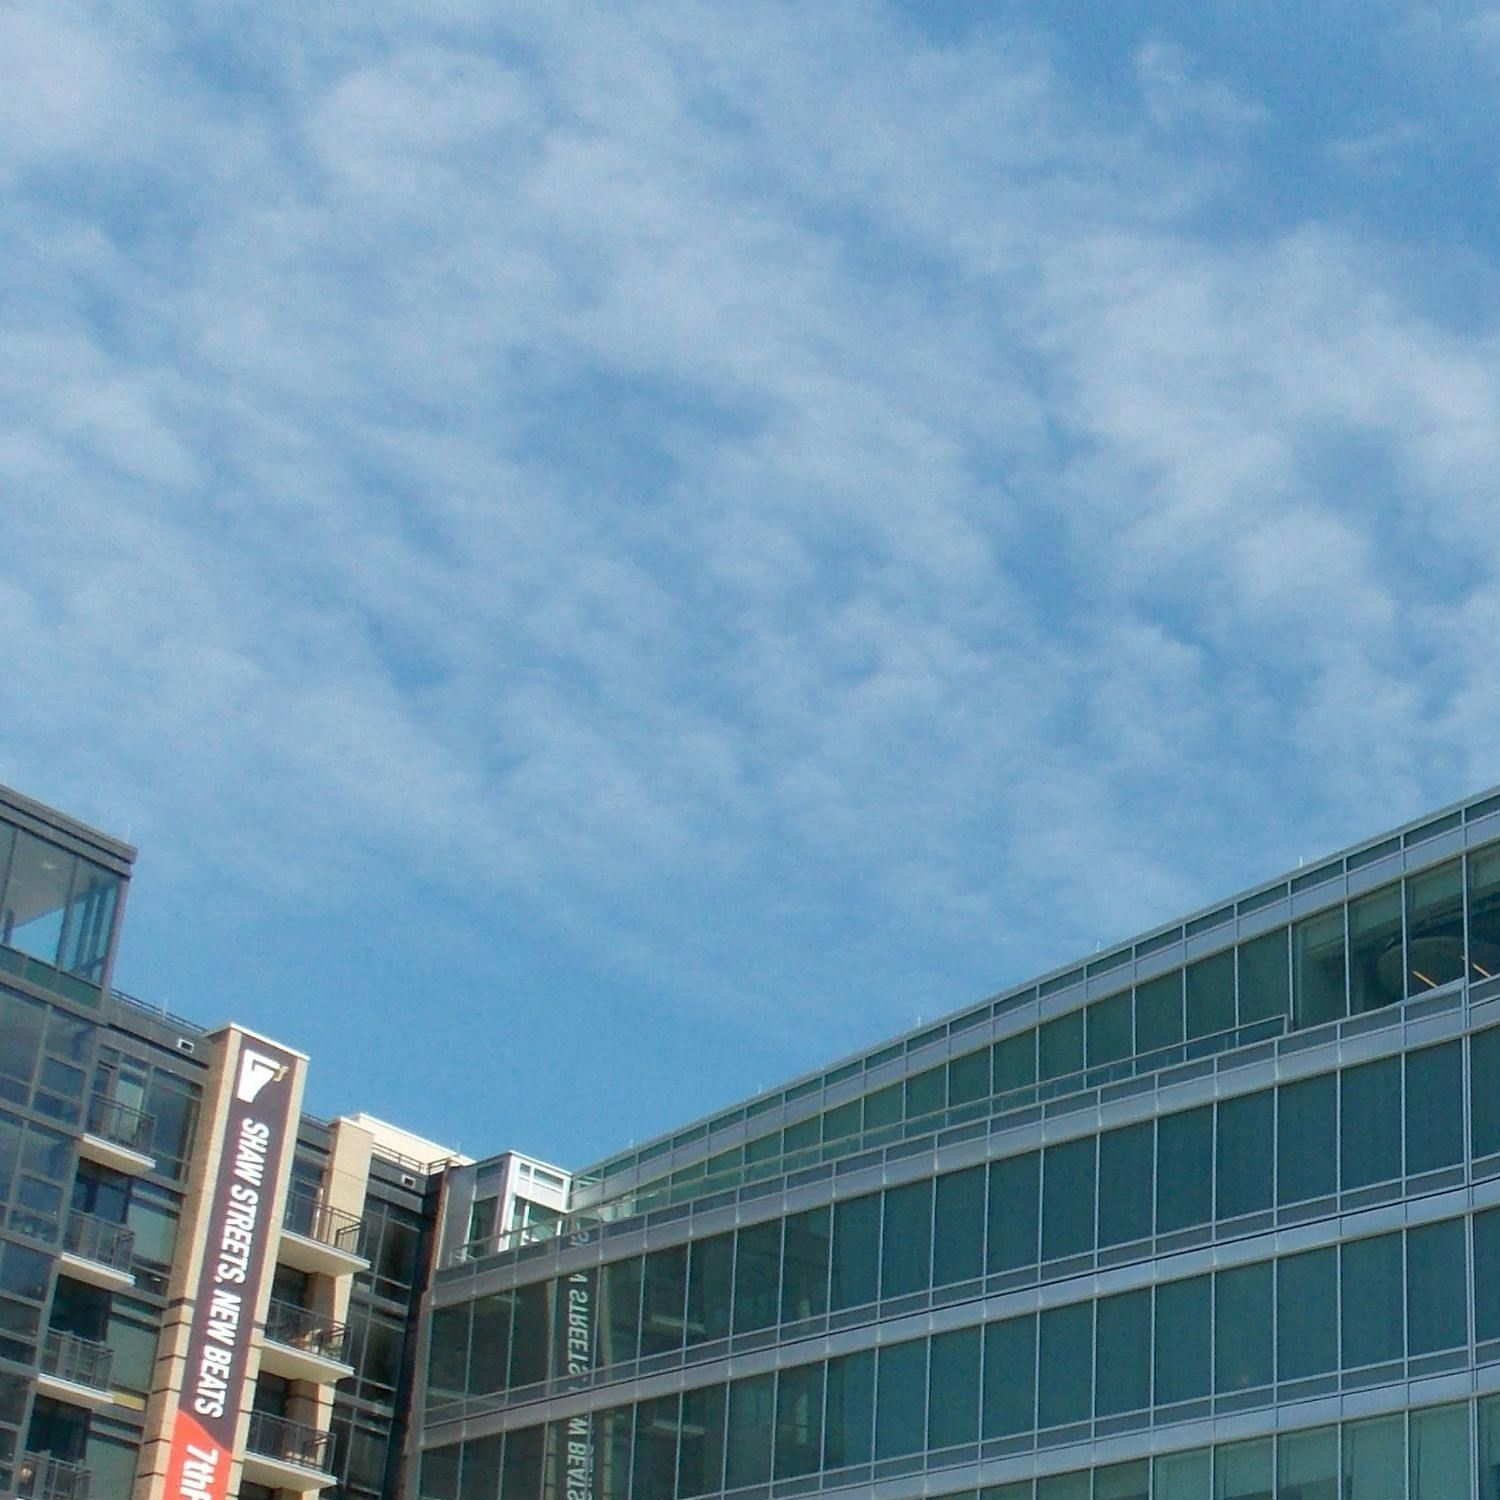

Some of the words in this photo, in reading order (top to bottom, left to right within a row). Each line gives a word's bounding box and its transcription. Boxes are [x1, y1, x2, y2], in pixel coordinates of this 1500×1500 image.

[233, 1117, 269, 1187] SHAW
[206, 1288, 241, 1346] NEW
[194, 1344, 232, 1419] BEATS
